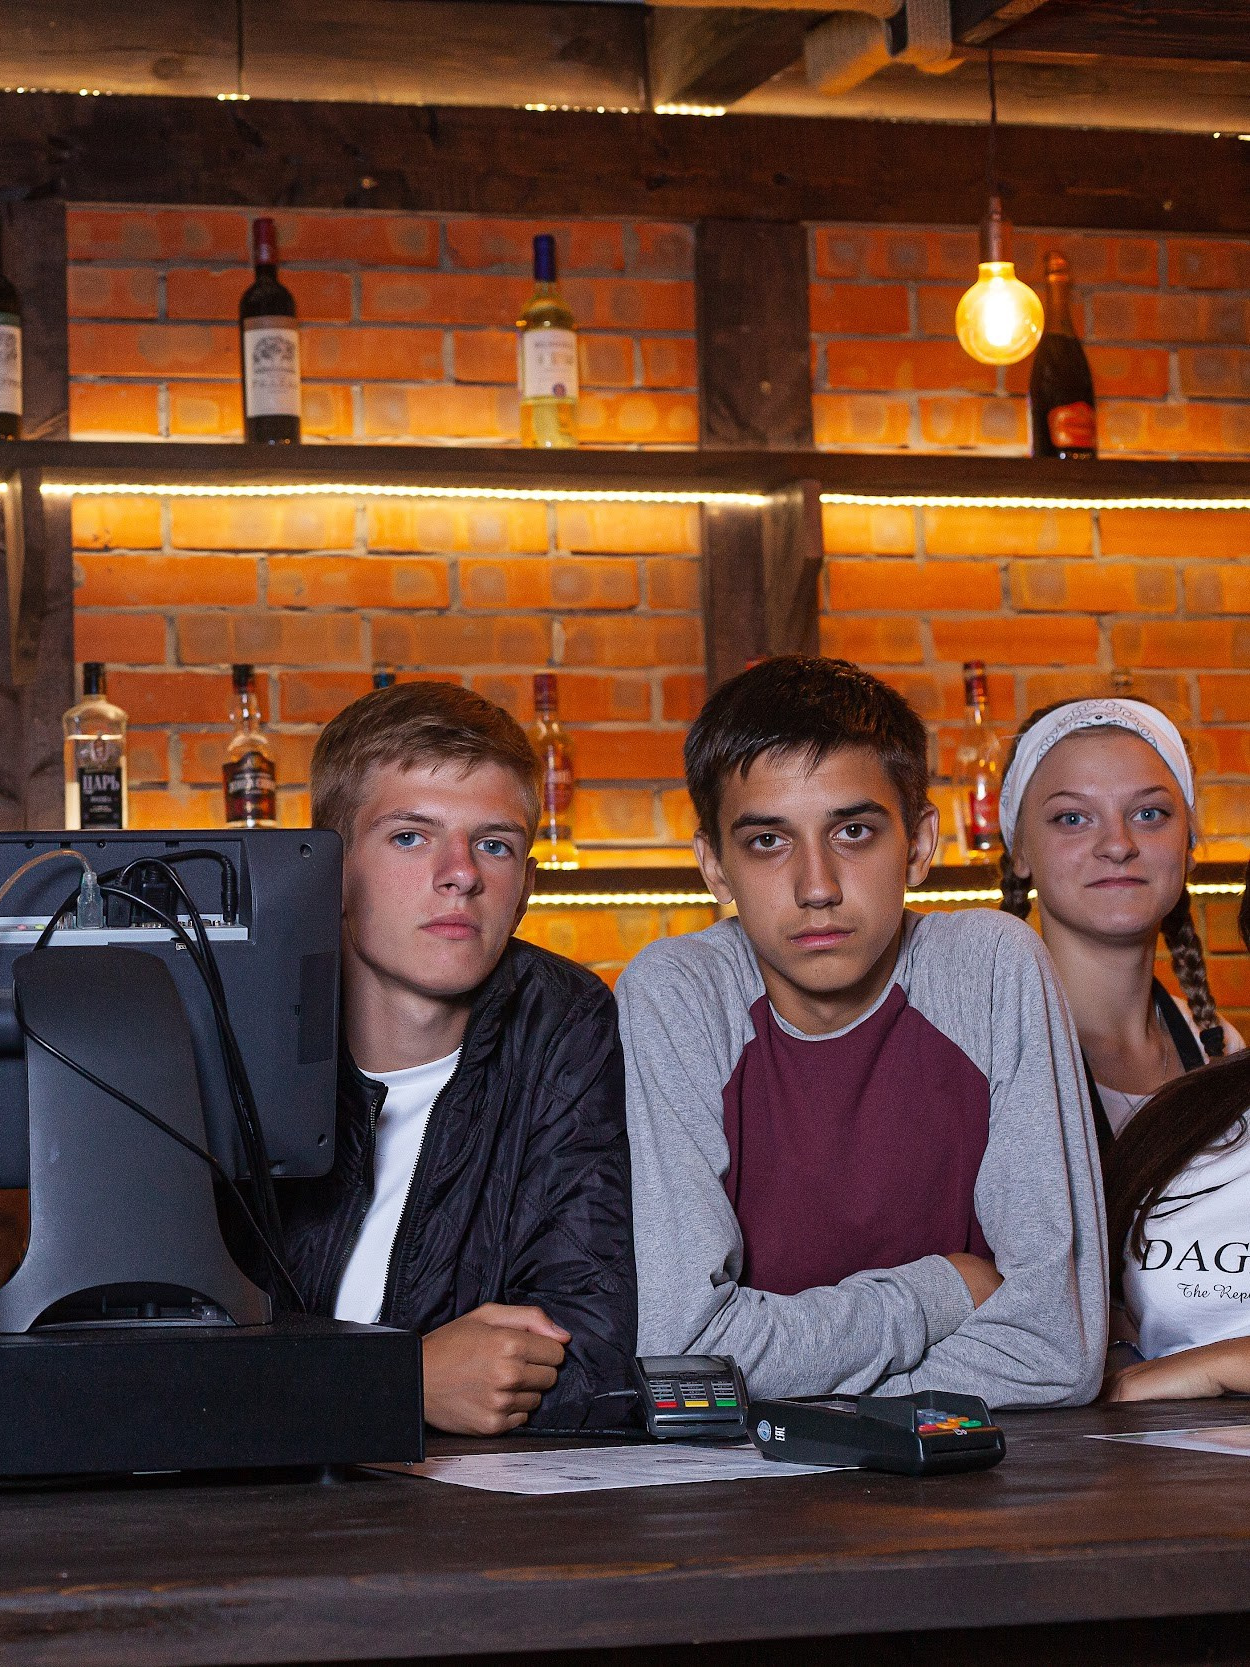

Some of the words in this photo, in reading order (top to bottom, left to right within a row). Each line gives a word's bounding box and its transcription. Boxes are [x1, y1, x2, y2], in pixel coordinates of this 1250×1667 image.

[1138, 1239, 1250, 1274] DAG
[1177, 1282, 1210, 1298] The
[1213, 1284, 1250, 1304] Rep
